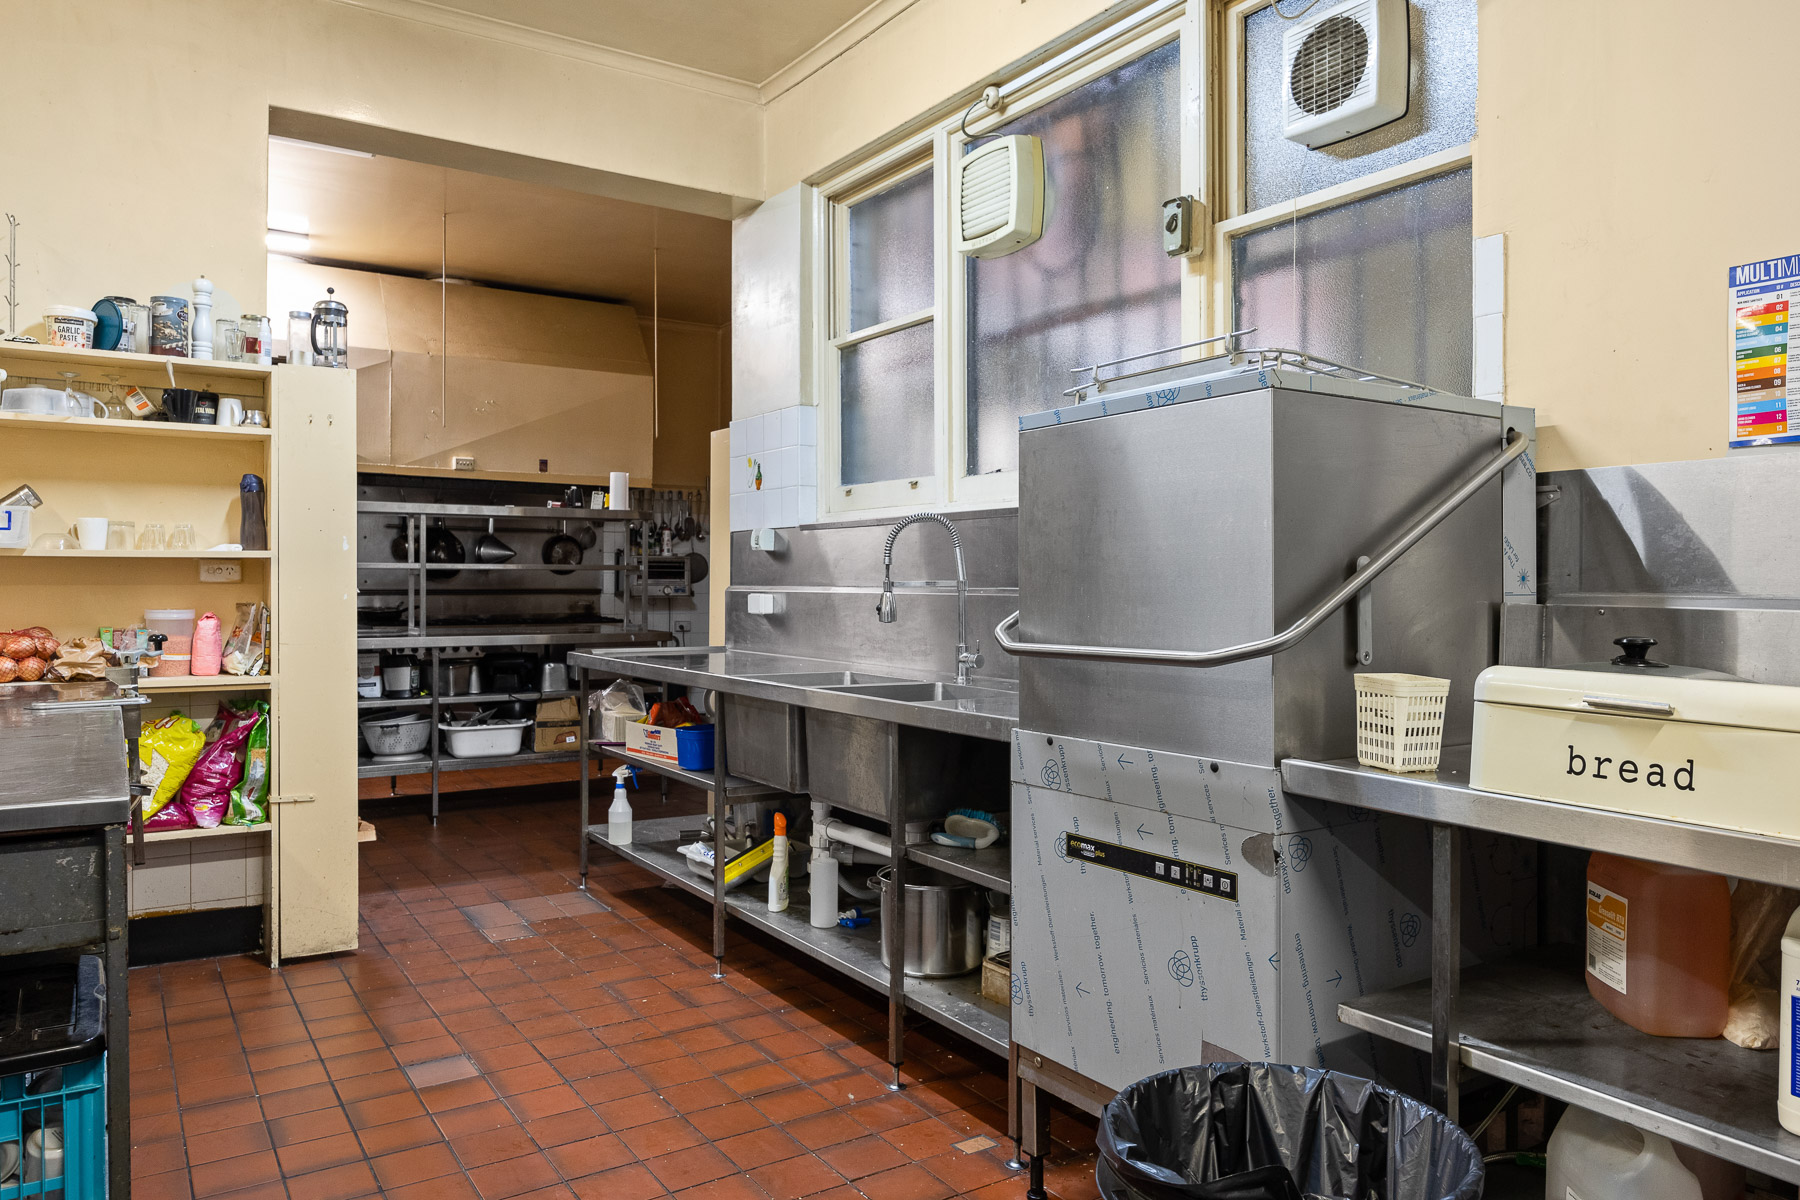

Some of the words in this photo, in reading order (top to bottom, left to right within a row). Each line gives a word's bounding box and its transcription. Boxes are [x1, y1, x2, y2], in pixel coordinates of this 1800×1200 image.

[1736, 255, 1800, 285] MULTIMI
[1775, 303, 1783, 311] 02
[57, 325, 81, 335] GARLIC
[59, 334, 78, 343] PASTE
[1775, 325, 1783, 333] 04
[1773, 356, 1781, 364] 07
[1773, 378, 1781, 386] 09
[1058, 744, 1073, 794] yssenkrupp
[1566, 744, 1696, 792] bread
[1150, 764, 1167, 813] ngineering.
[1203, 784, 1215, 815] services
[1267, 786, 1284, 831] together.
[1030, 812, 1039, 840] services
[1034, 840, 1043, 866] Material
[1070, 838, 1096, 852] ecomax
[1221, 832, 1232, 866] Services
[1089, 910, 1101, 950] together.
[1132, 914, 1144, 951] materiales
[1235, 909, 1247, 941] Material
[1098, 952, 1110, 998] tomorrow.
[1140, 952, 1150, 985] Servicios
[1190, 935, 1209, 1002] thyssenkrupp
[1020, 961, 1035, 1018] thyssenkrupp
[1057, 970, 1068, 1005] materiales
[1294, 932, 1309, 991] engineering.
[1305, 989, 1319, 1038] tomorrow.
[1314, 1036, 1326, 1069] togeth
[1063, 1006, 1073, 1037] Servicios
[1244, 951, 1272, 1059] Werkstoff-Dienstleistungen
[1106, 998, 1121, 1055] engineering.
[1154, 1033, 1165, 1064] Services
